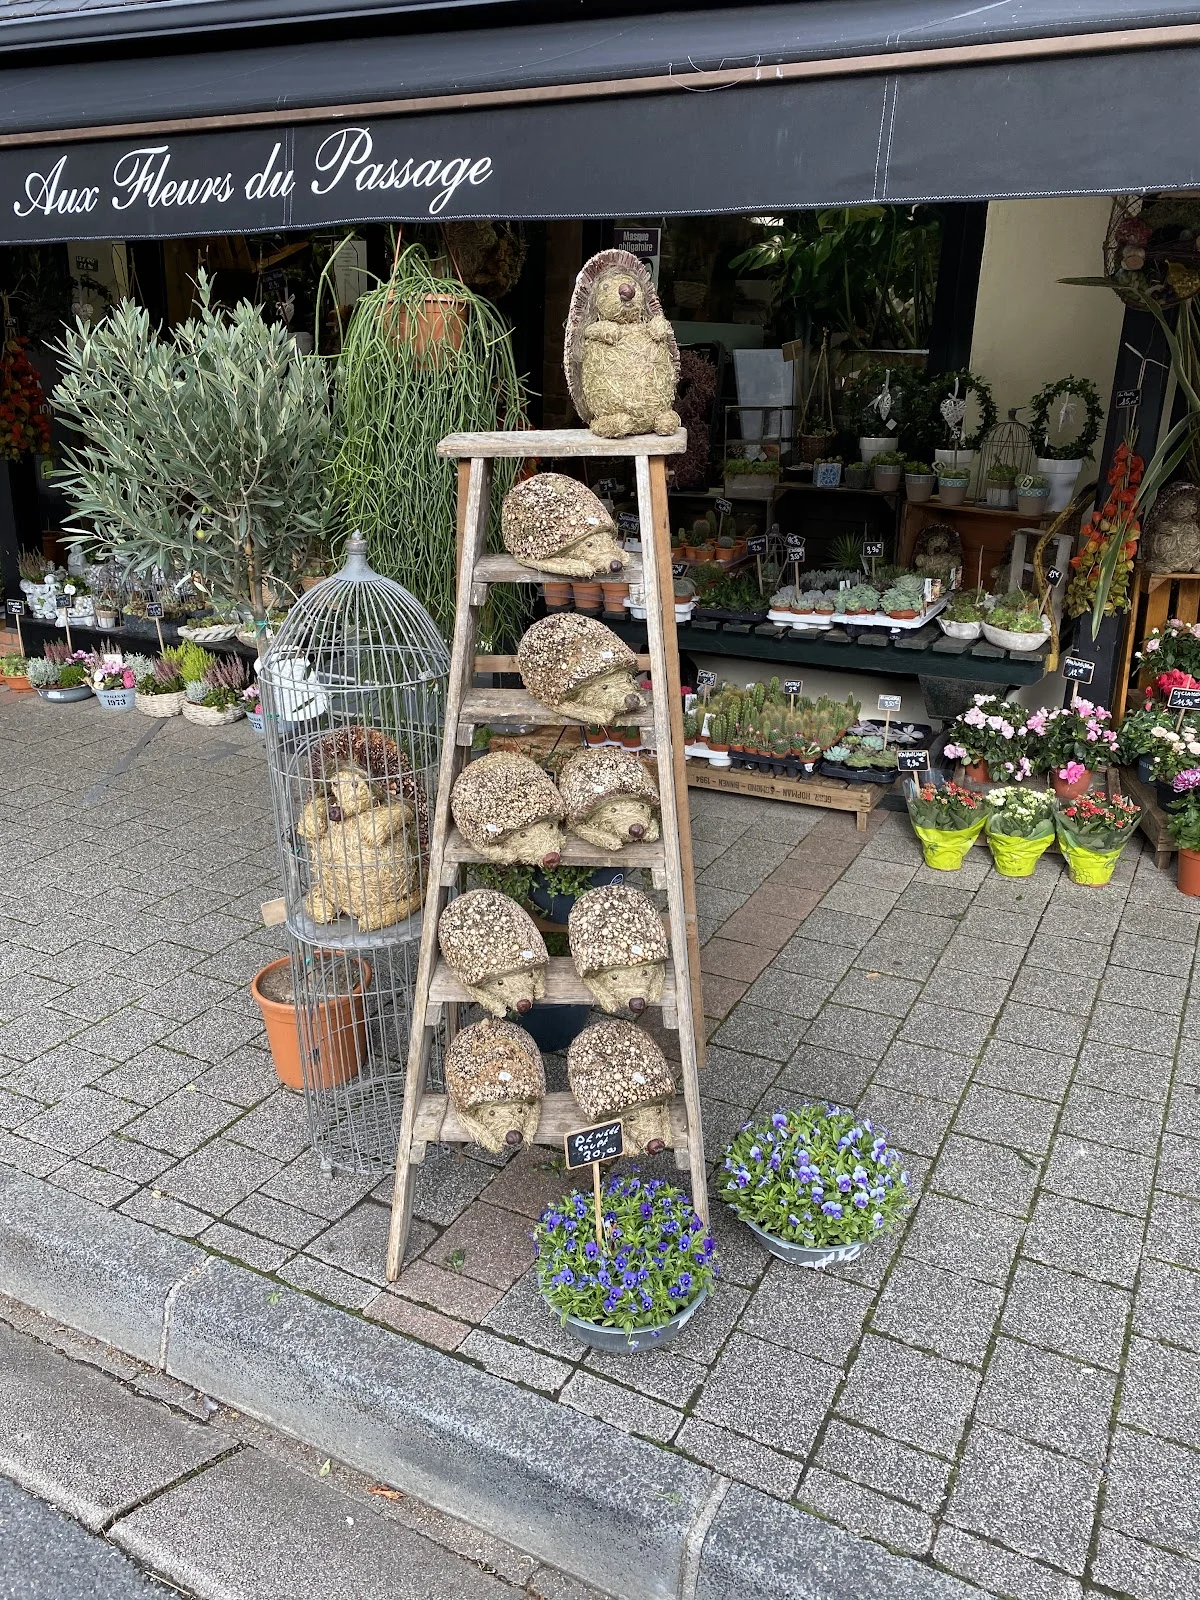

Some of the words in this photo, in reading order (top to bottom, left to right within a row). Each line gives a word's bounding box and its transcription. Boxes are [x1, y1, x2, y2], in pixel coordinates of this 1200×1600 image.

[13, 155, 100, 217] Aux
[112, 145, 235, 210] Fleurs
[244, 142, 296, 200] du
[311, 127, 494, 214] Passage
[623, 231, 650, 243] Masque
[618, 241, 653, 253] obligatoire
[695, 775, 711, 785] 1994
[718, 779, 740, 790] BINNEN
[782, 788, 811, 800] HOPMAN
[575, 1124, 620, 1147] PENSEE
